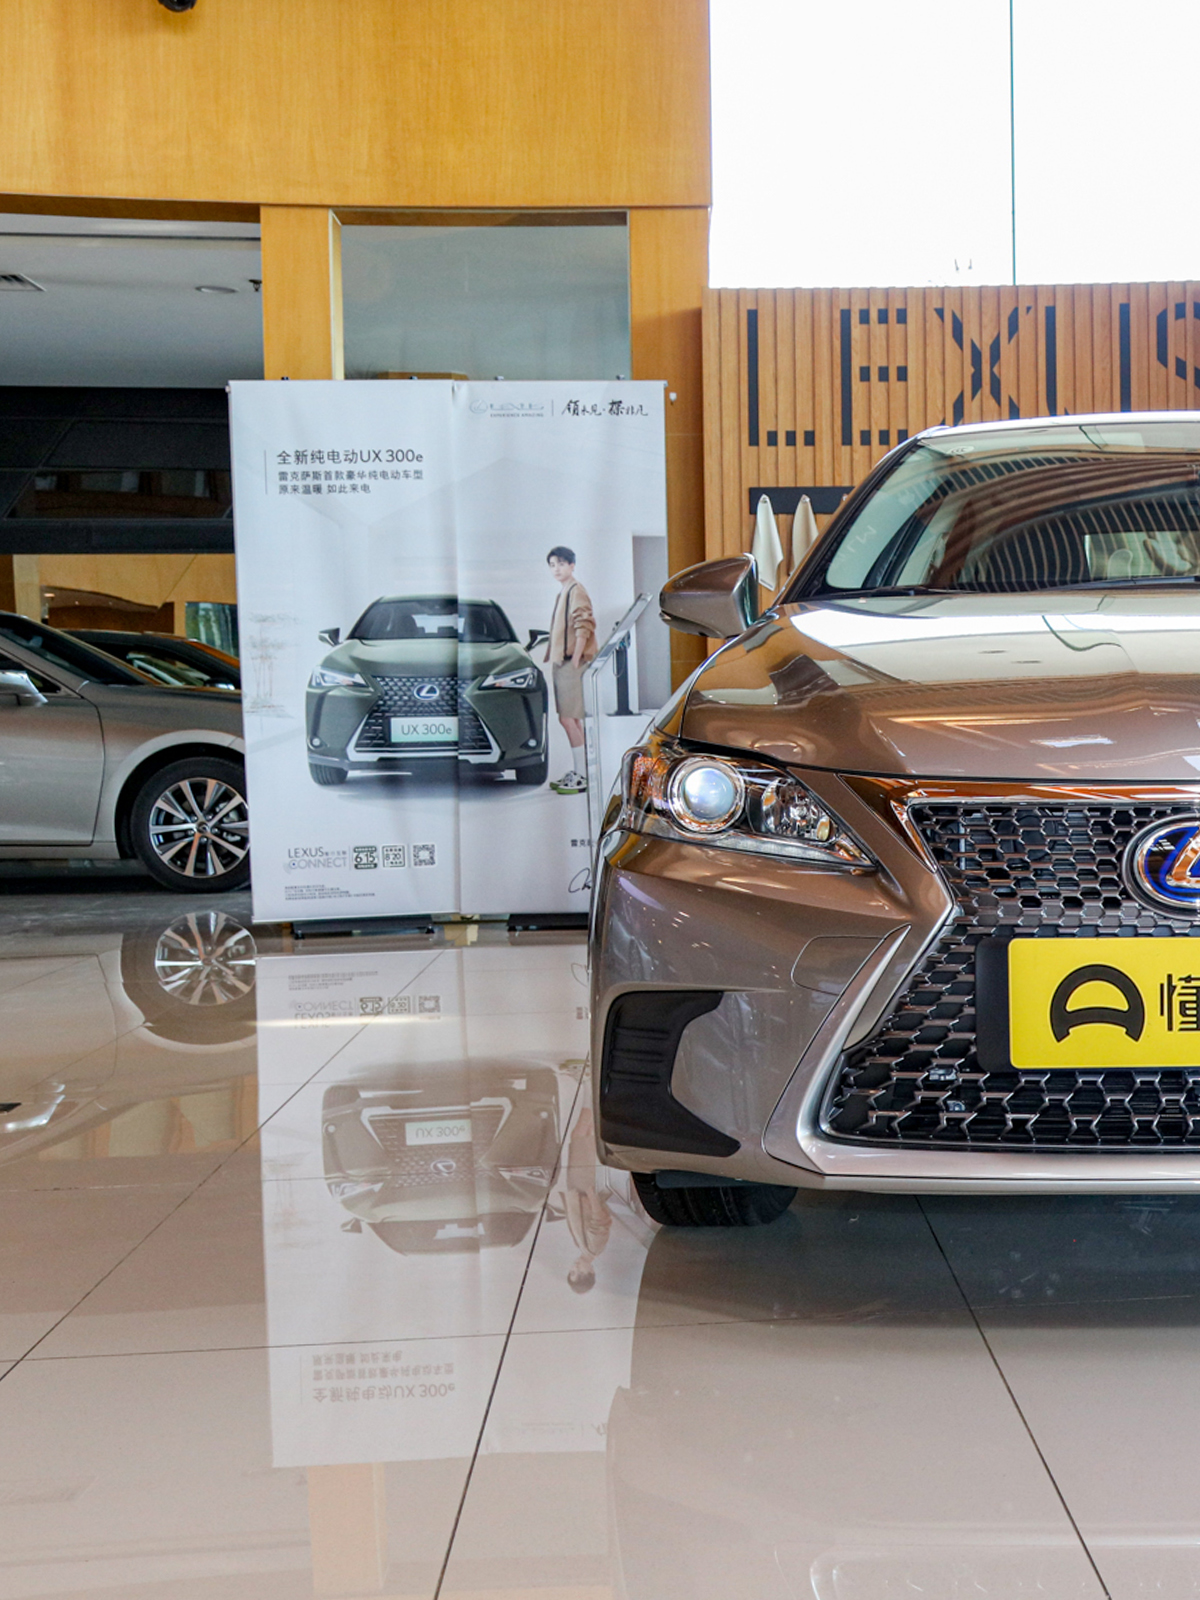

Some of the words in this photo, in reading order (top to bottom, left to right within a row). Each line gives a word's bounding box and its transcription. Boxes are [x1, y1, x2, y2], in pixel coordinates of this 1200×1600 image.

[385, 449, 424, 463] 300e
[401, 724, 420, 736] UX
[422, 723, 453, 735] 300e
[287, 846, 325, 859] LEXUS
[288, 857, 347, 870] CONNECT
